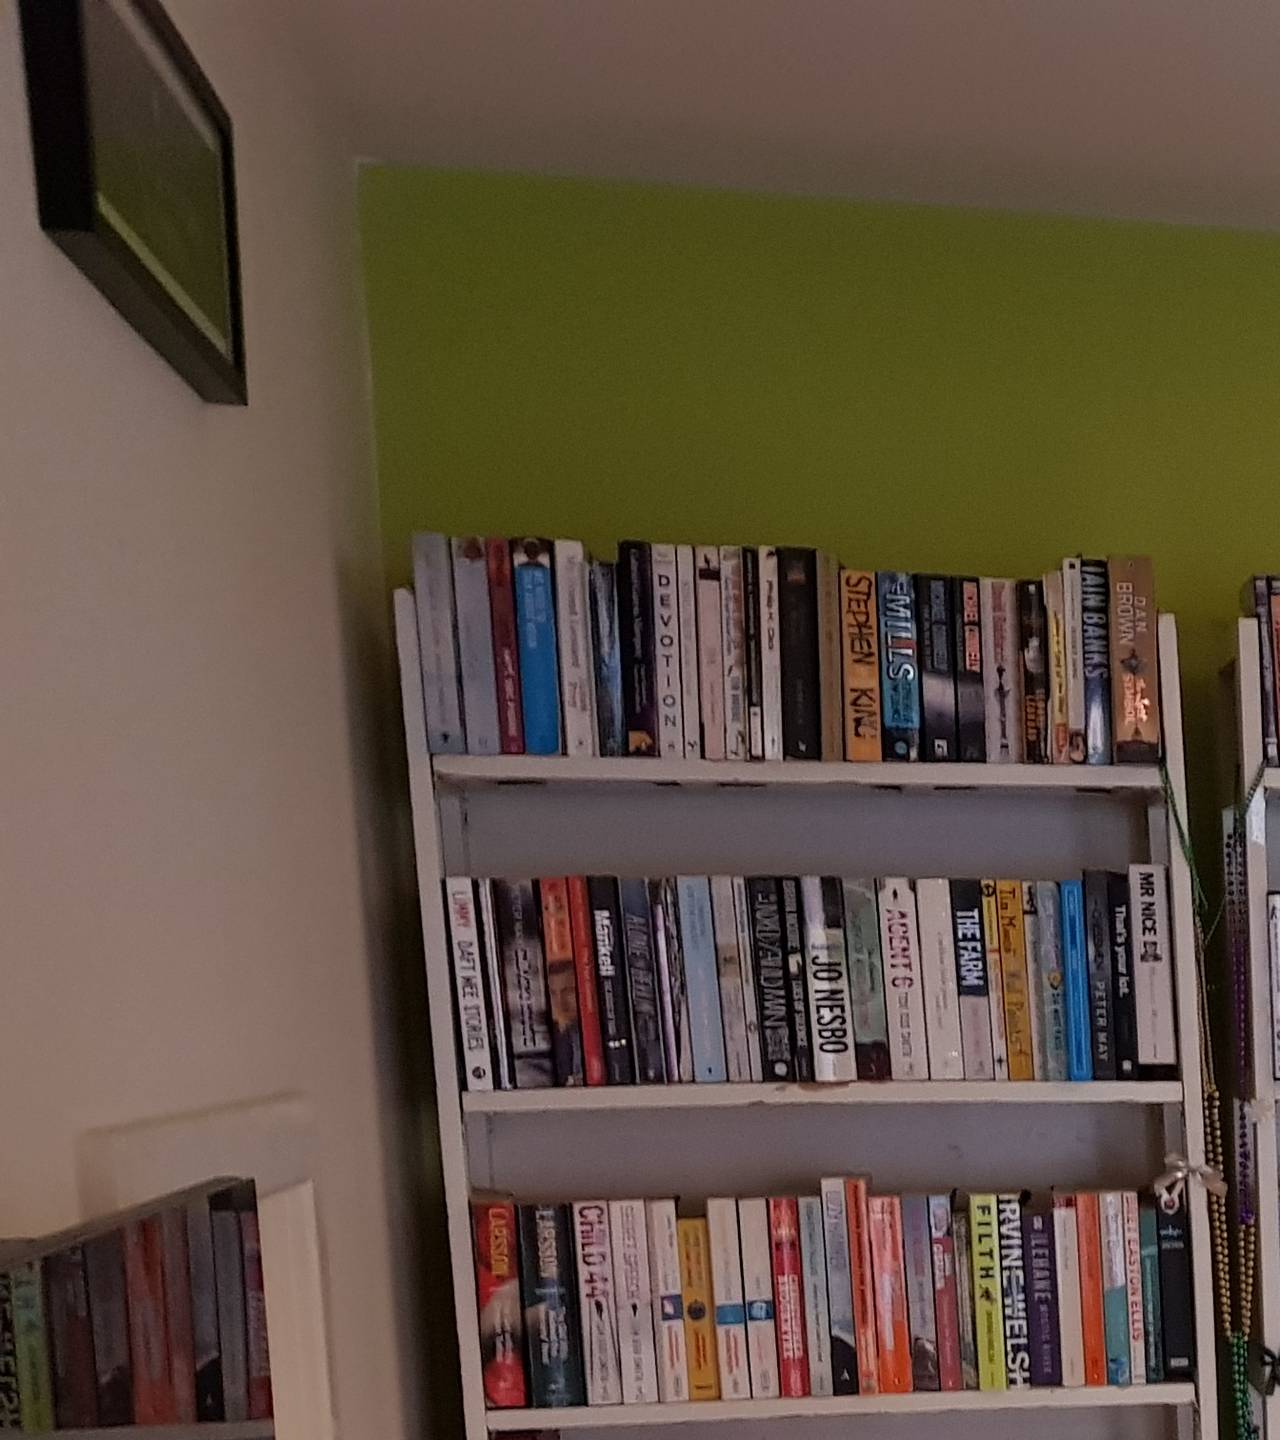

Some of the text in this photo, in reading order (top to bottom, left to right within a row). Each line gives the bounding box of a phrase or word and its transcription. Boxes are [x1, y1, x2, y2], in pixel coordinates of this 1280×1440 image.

[884, 593, 915, 681] MILLS
[1082, 611, 1108, 680] BANKS
[1115, 582, 1135, 646] BROWN
[1133, 596, 1148, 634] DAN
[656, 574, 677, 728] DEVOTION
[845, 575, 878, 739] STEPHEN KING
[1139, 872, 1158, 937] MR NICE
[457, 940, 476, 973] DAFT
[811, 955, 844, 983] JO
[956, 908, 985, 987] THE FARM
[1093, 980, 1110, 1061] PETER MAY
[976, 1203, 996, 1281] FILTH
[1030, 1237, 1052, 1302] LEHANE
[1004, 1292, 1030, 1388] WELSH
